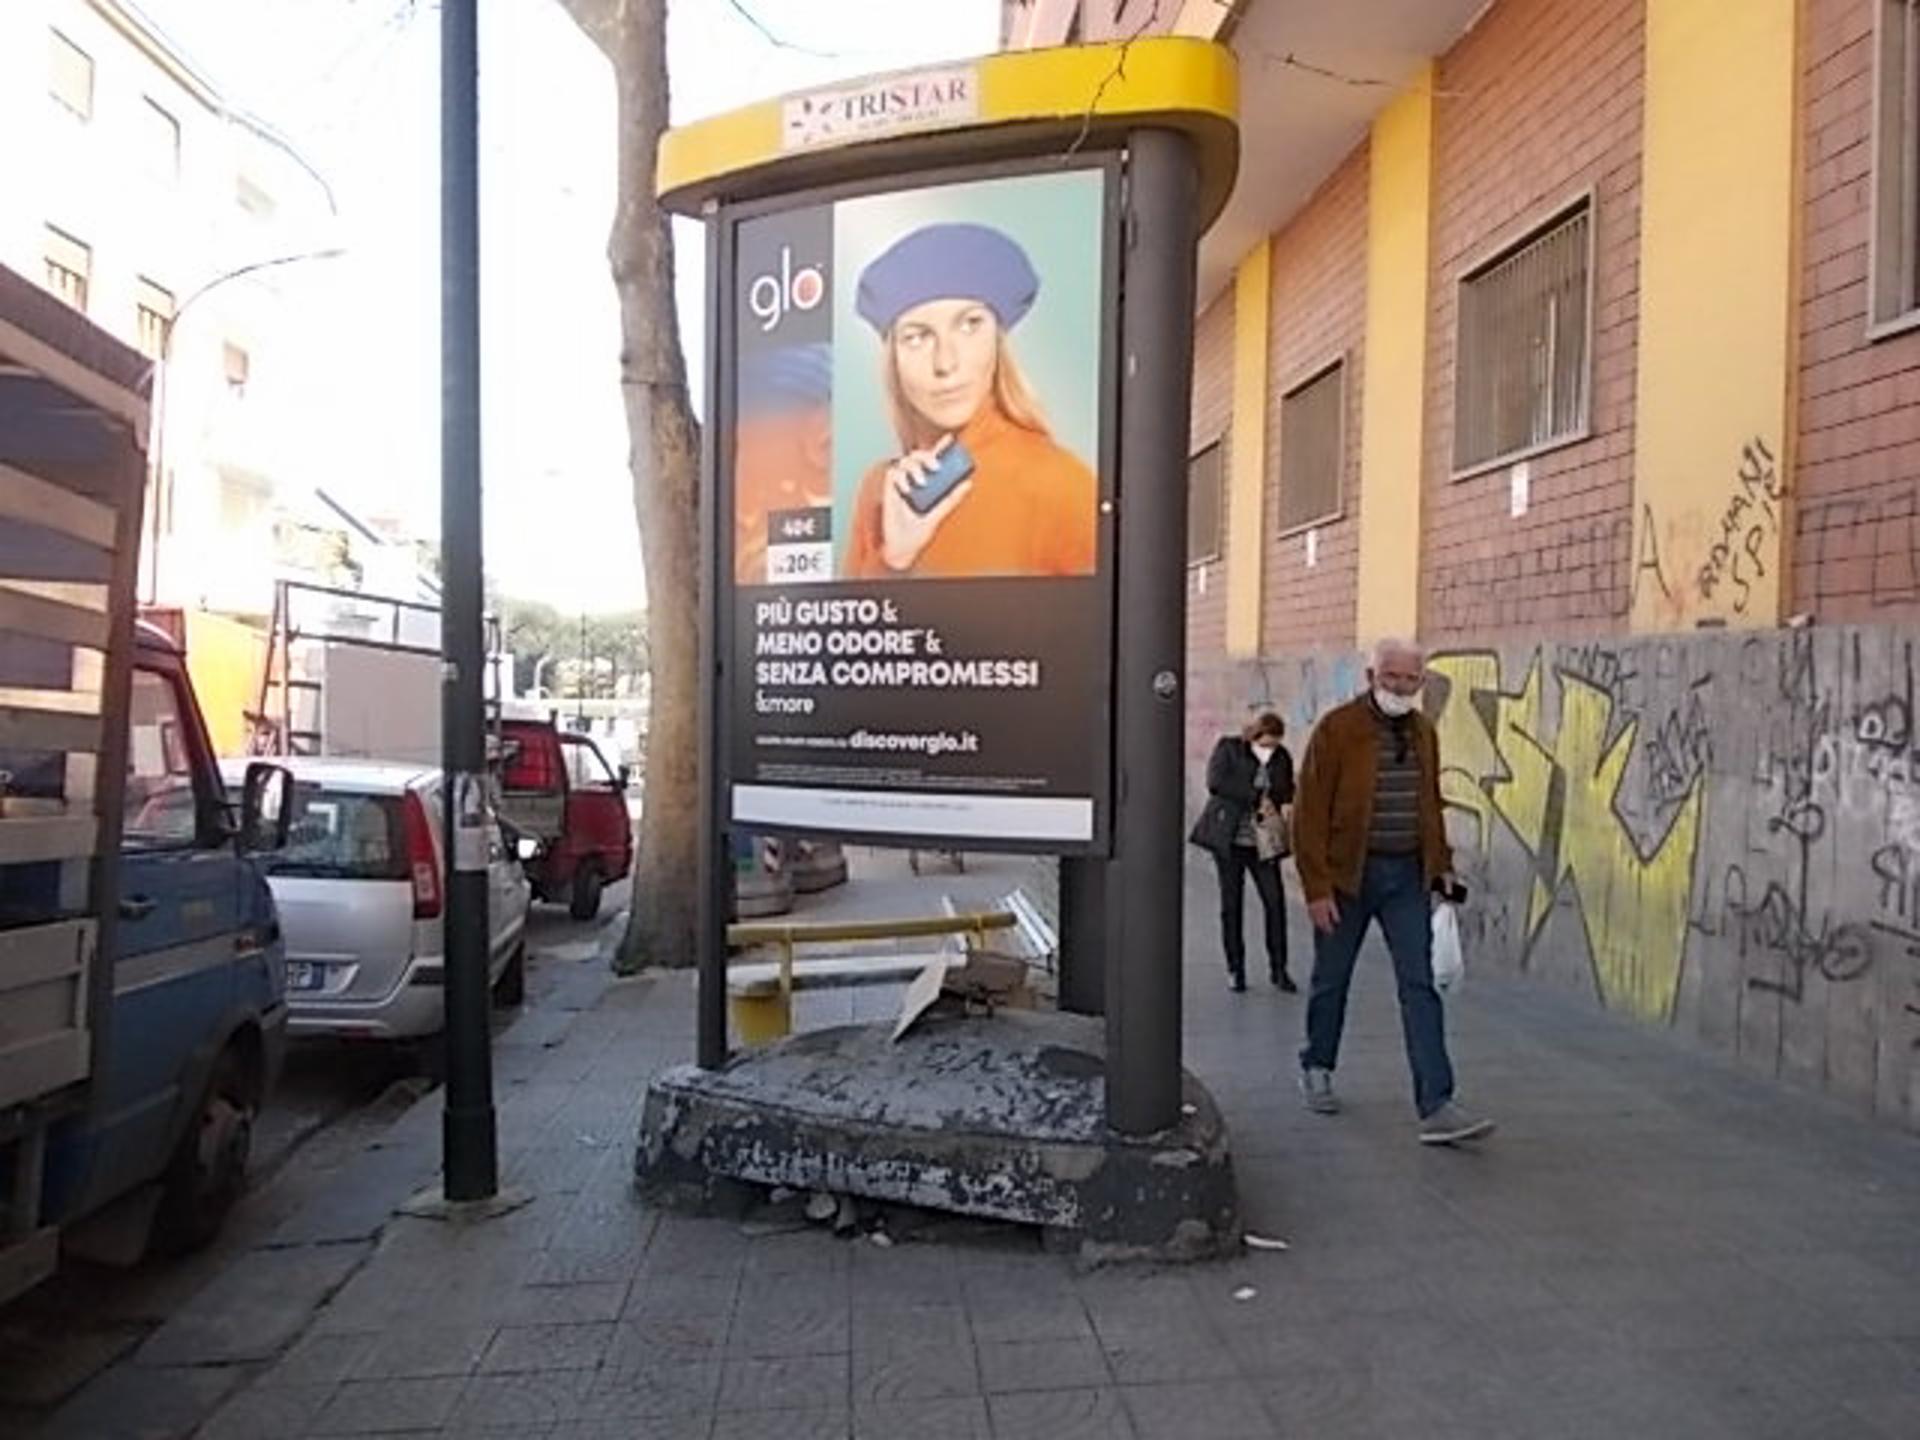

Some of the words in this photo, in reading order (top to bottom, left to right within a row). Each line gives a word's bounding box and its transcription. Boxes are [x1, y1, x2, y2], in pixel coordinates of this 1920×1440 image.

[840, 79, 966, 119] TRISTAR
[750, 245, 824, 332] glo
[756, 596, 793, 625] PIÙ
[796, 600, 879, 625] GUSTO
[881, 599, 898, 622] &
[756, 631, 823, 655] MENO
[925, 629, 942, 654] &
[756, 661, 827, 685] SENZA
[831, 660, 1039, 687] COMPROMESSI
[850, 730, 979, 755] discoverglo.it
